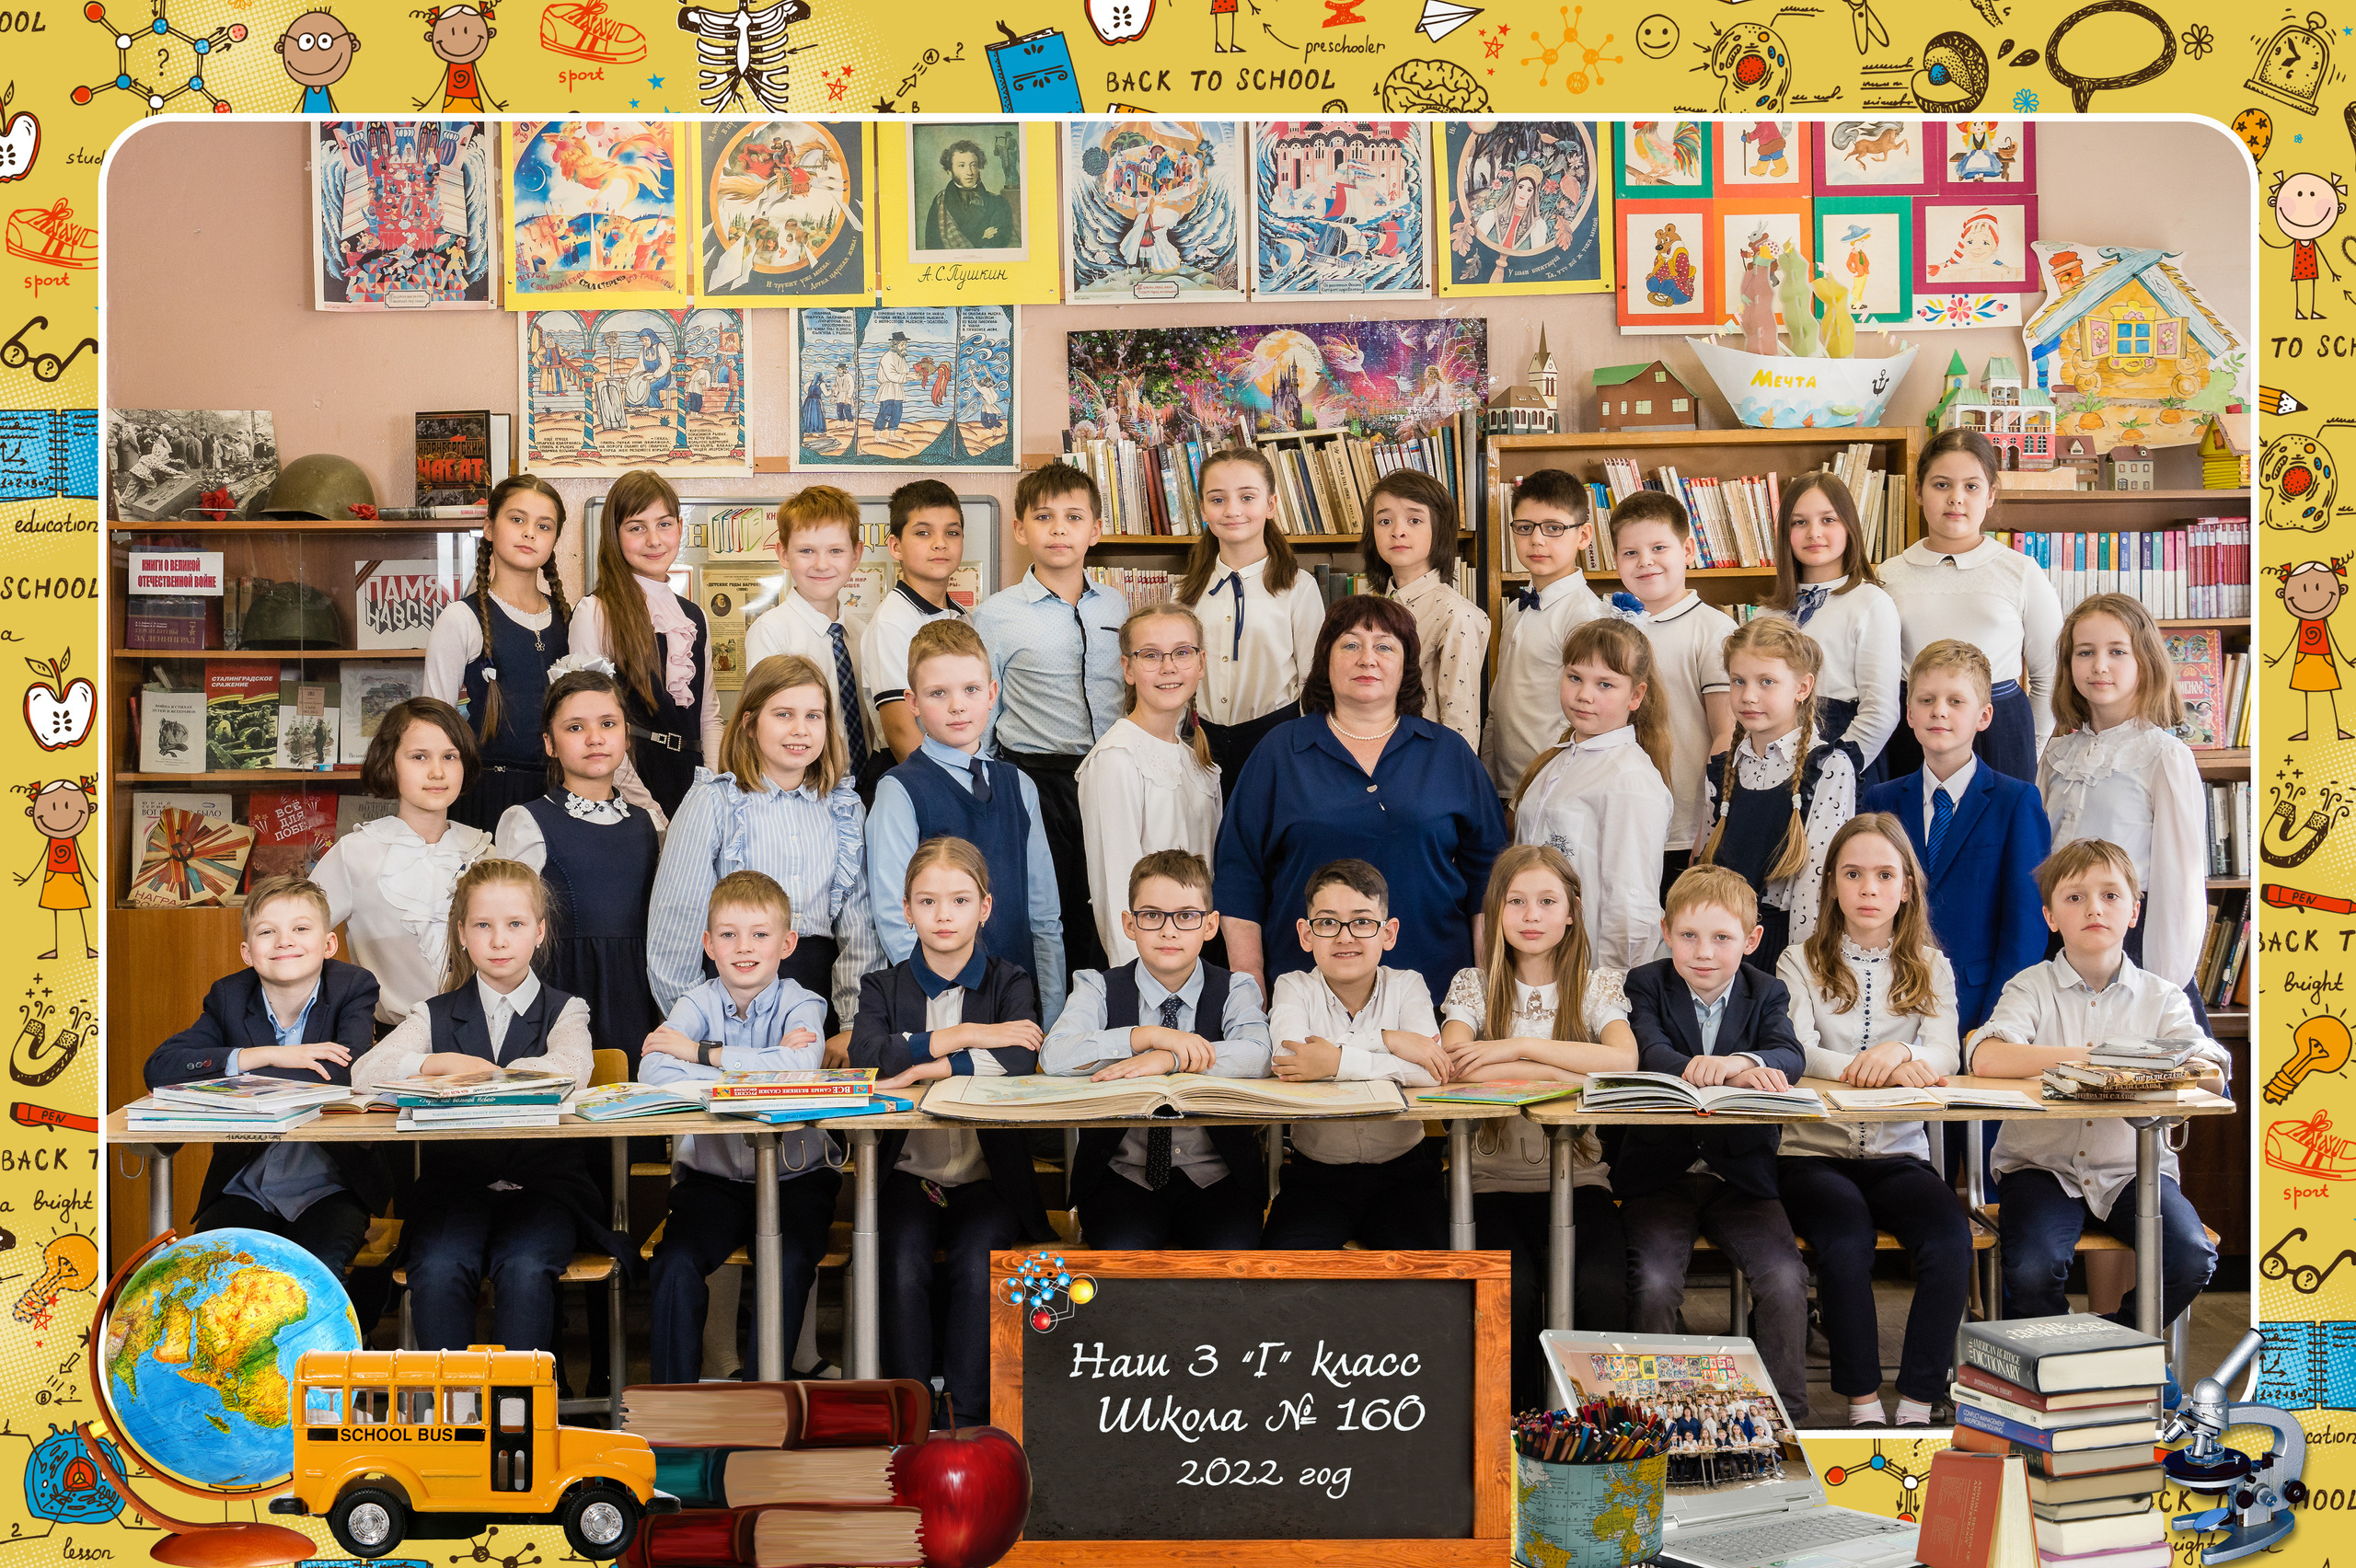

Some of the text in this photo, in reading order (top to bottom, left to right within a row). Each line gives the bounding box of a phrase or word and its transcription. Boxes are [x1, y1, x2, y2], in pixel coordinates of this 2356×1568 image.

[578, 278, 597, 291] СТАЛ
[417, 458, 483, 482] НАБАТ
[142, 557, 201, 571] КНИГИ О ВЕЛИКОЙ
[138, 573, 216, 588] ОТЕЧЕСТВЕННОЙ ВОЙНЕ
[146, 636, 196, 644] ЛЕНИНГРАД
[274, 799, 303, 819] ВСЁ
[279, 810, 306, 830] ДЛЯ
[2163, 1072, 2187, 1080] СЛАВЫ
[832, 1085, 851, 1094] ВСЕ
